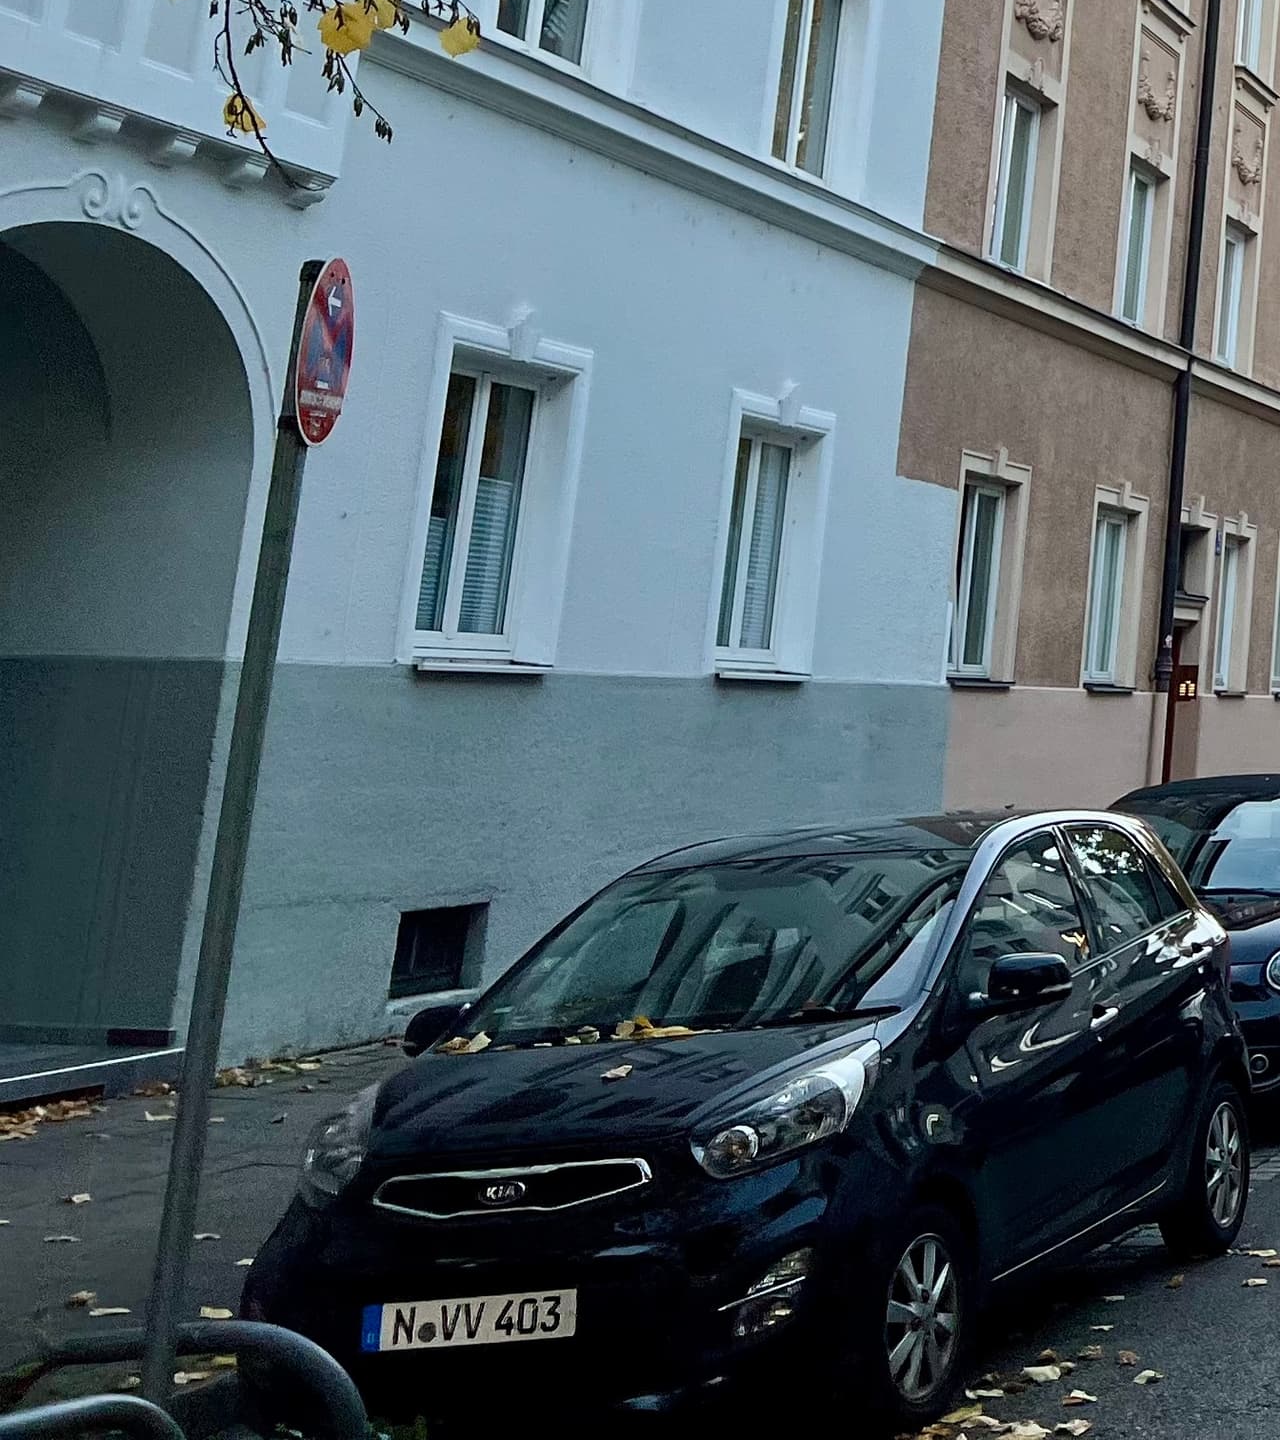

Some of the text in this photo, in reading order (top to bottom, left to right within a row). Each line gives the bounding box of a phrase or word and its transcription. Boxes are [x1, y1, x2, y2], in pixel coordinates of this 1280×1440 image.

[486, 1185, 515, 1200] KIA
[392, 1306, 416, 1345] N
[494, 1295, 562, 1336] 403
